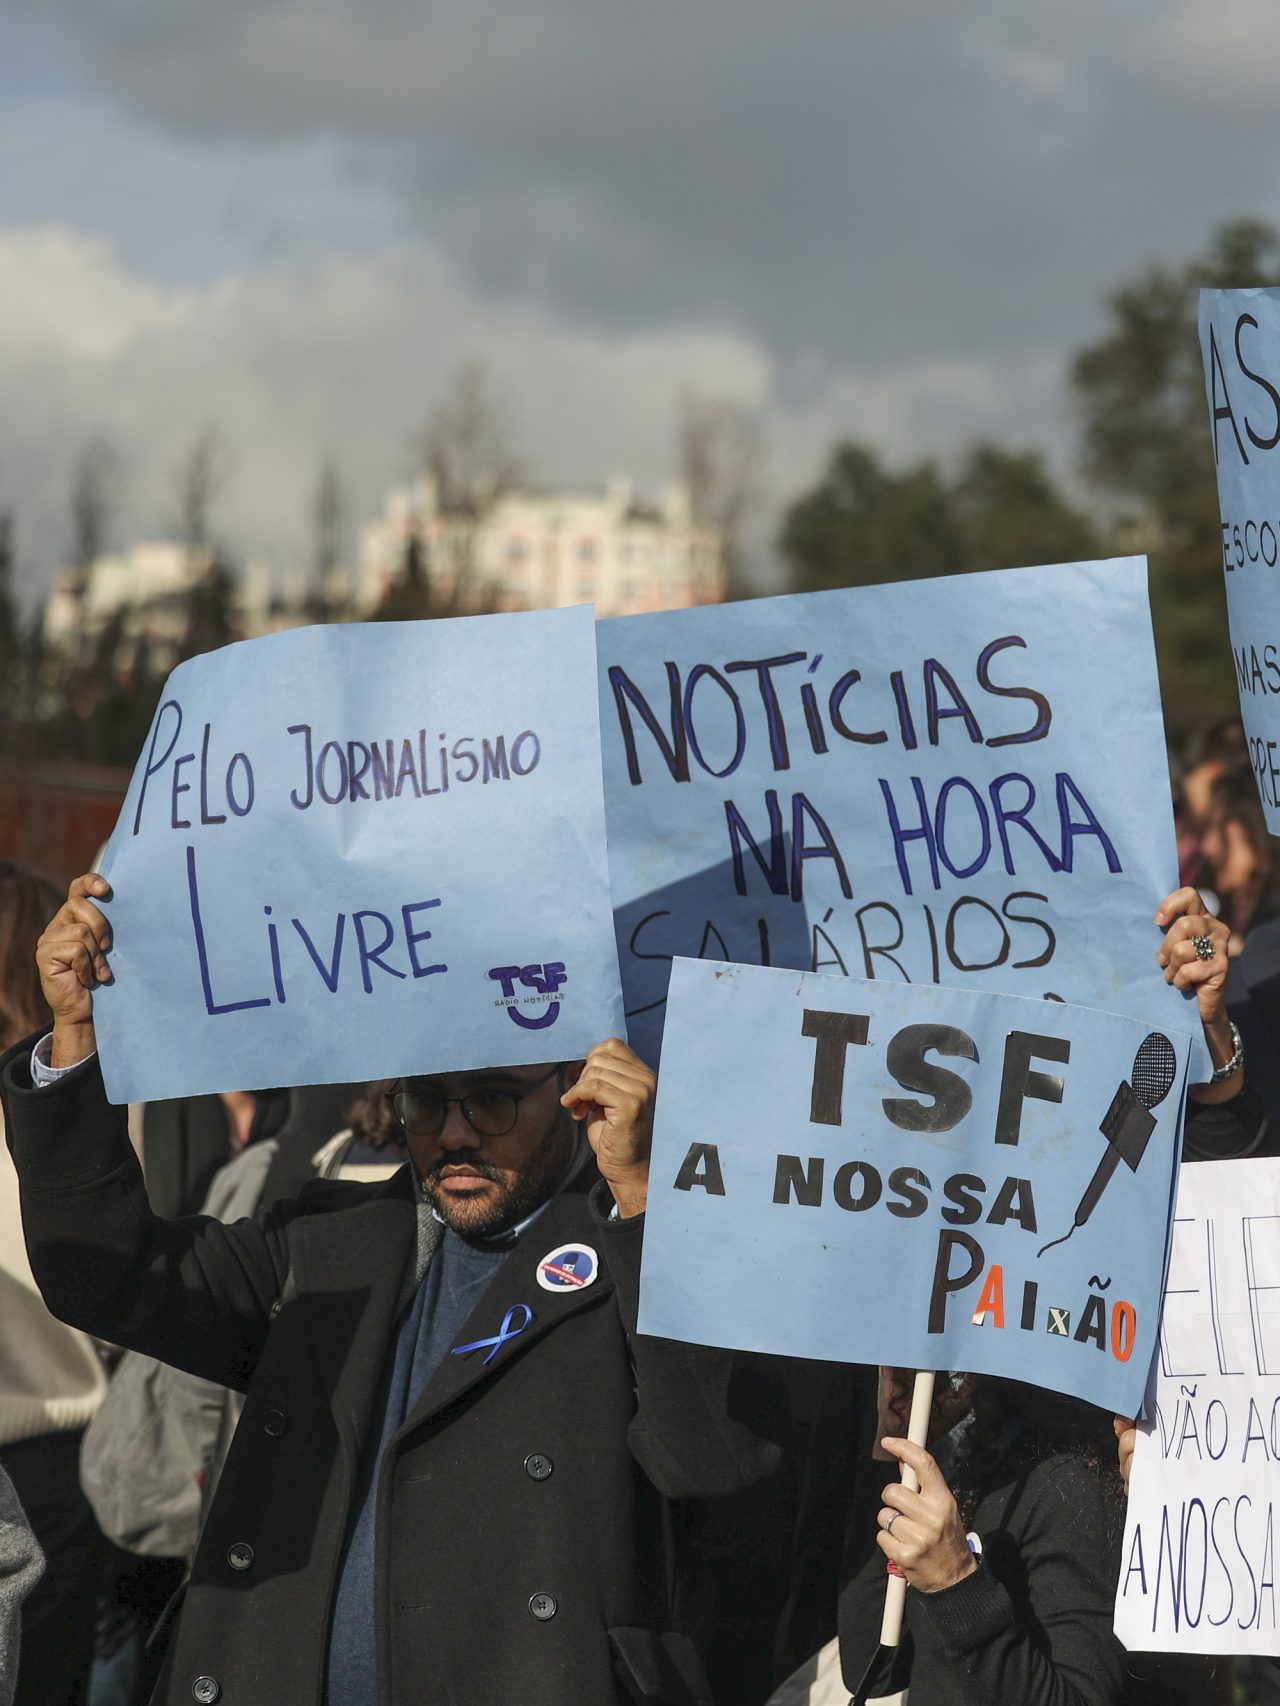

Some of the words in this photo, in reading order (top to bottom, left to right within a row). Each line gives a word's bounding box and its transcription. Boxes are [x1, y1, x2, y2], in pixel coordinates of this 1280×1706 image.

[133, 700, 254, 835] PELO
[724, 790, 853, 901] NA
[878, 772, 1122, 895] HORA
[488, 962, 568, 997] TSF
[802, 1009, 1071, 1146] TSF
[673, 1142, 725, 1196] A
[773, 1154, 1037, 1233] NOSSA
[1123, 1524, 1148, 1596] A
[1152, 1495, 1276, 1633] NOSSA
